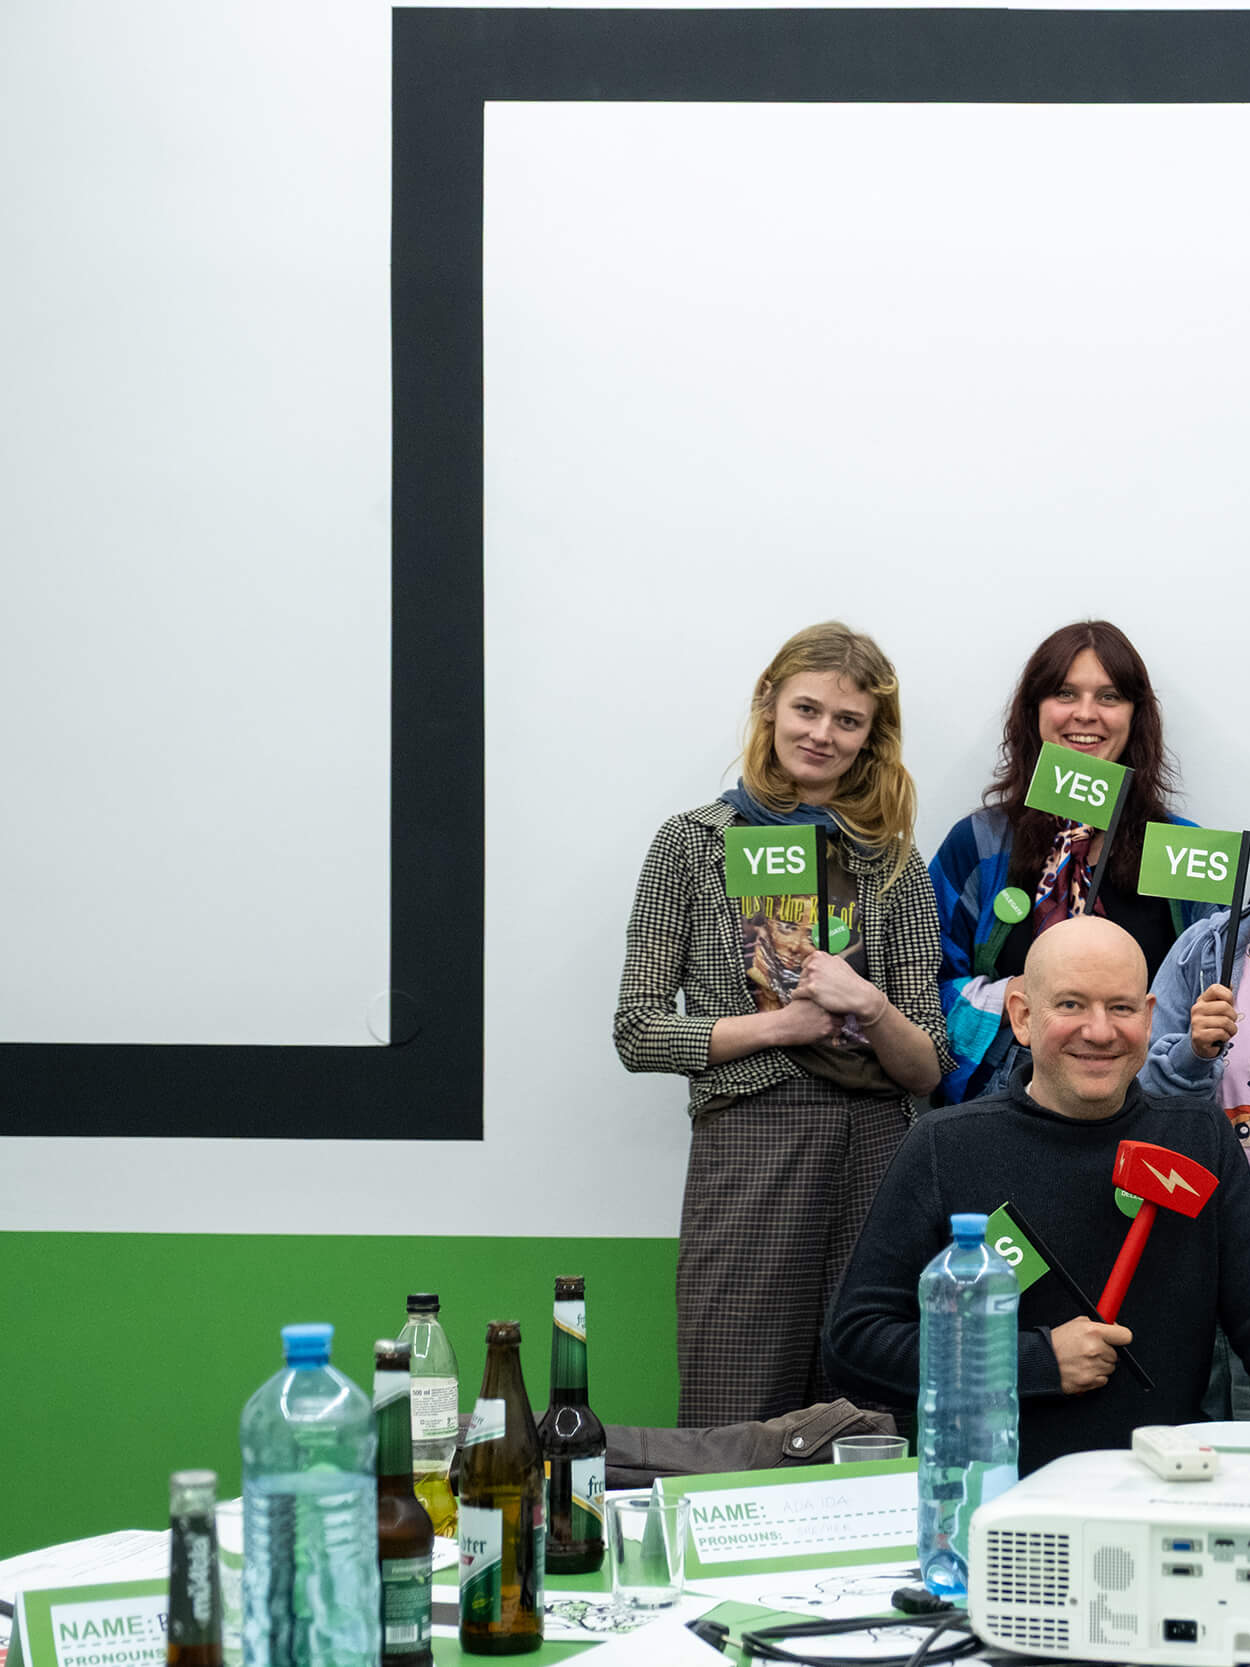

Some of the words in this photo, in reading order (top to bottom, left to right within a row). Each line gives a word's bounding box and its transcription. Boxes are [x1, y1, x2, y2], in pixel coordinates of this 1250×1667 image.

[1054, 765, 1109, 807] YES
[743, 846, 806, 875] YES
[1165, 845, 1229, 881] YES
[809, 896, 836, 924] Ky
[841, 902, 856, 930] of
[692, 1502, 767, 1524] NAME:
[698, 1531, 784, 1548] PRONOUNS:
[59, 1615, 153, 1642] NAME:
[64, 1648, 167, 1667] PRONOUNS
